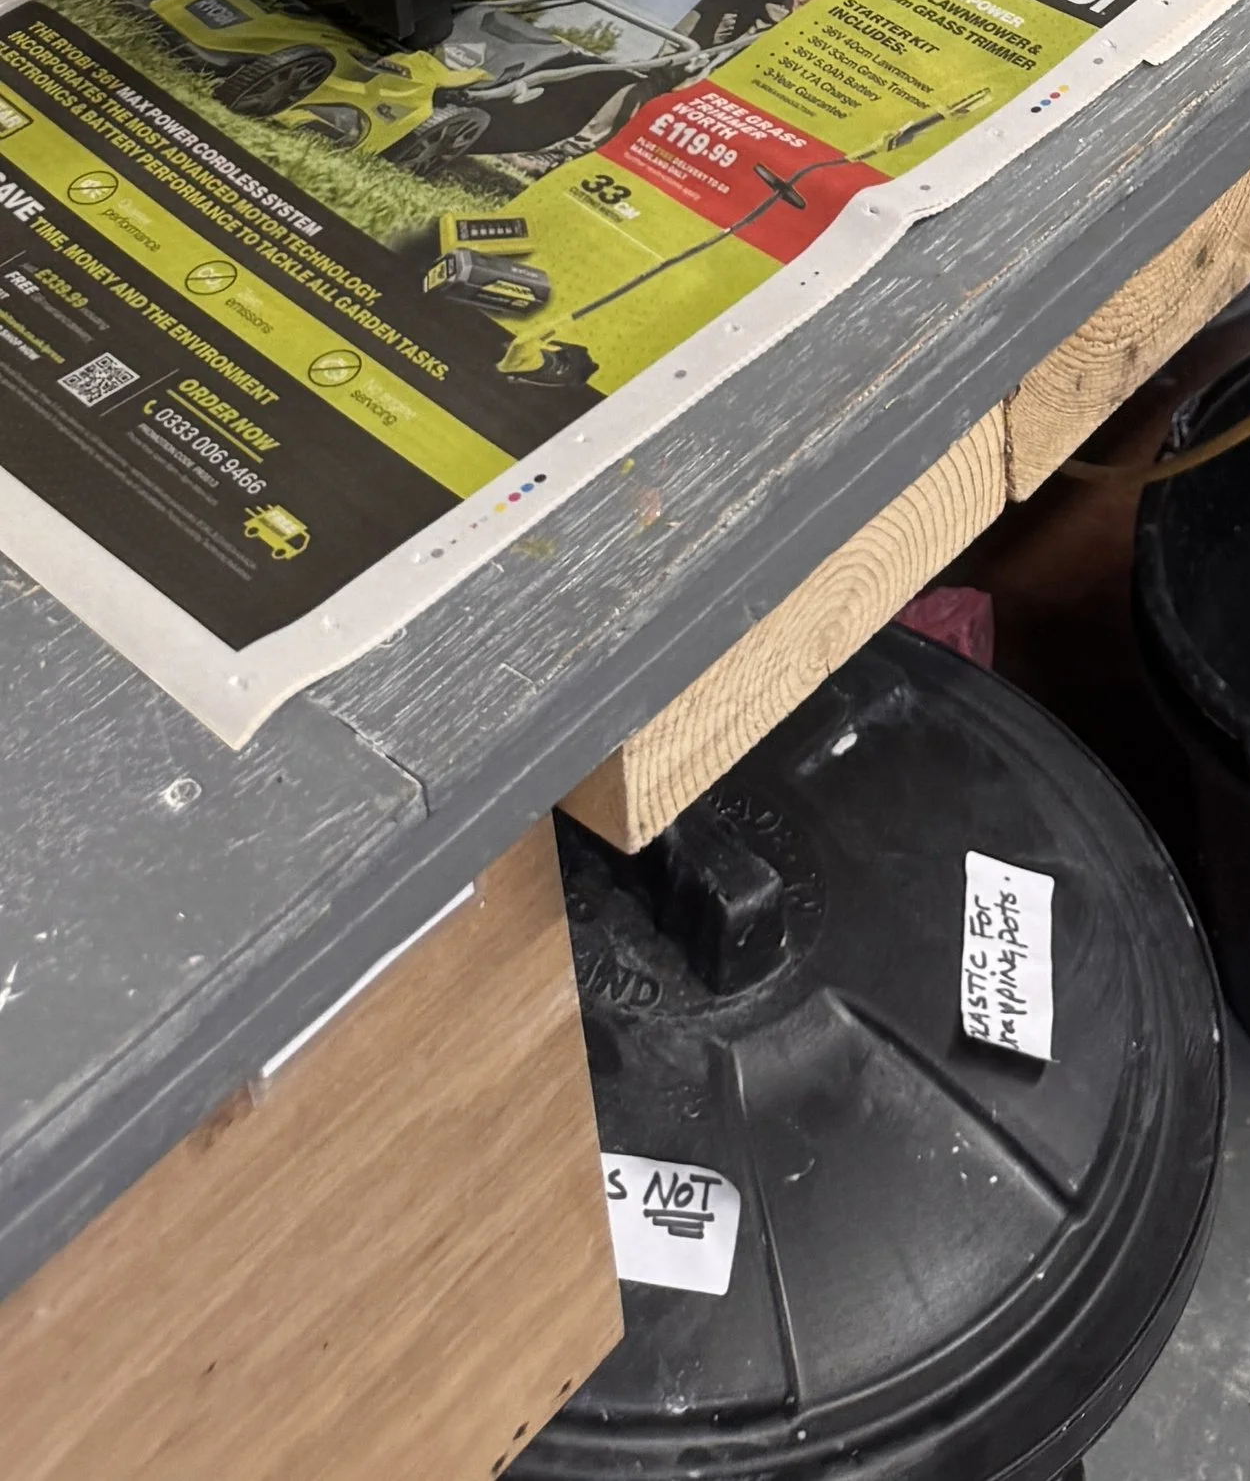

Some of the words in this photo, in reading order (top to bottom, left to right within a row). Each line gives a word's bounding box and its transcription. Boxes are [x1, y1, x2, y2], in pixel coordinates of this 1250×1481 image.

[828, 5, 909, 57] INCLUDES:
[909, 35, 941, 55] KIT
[912, 4, 968, 36] GRASS
[964, 31, 1038, 72] TRIMMER
[1026, 43, 1043, 56] &
[777, 55, 802, 74] 36V
[820, 80, 862, 110] Charger
[792, 45, 816, 62] 36V
[813, 57, 846, 82] 5.0Ah
[843, 76, 883, 103] Battery
[807, 35, 832, 51] 36V
[827, 47, 858, 70] 33cm
[856, 65, 889, 88] Grass
[887, 80, 931, 111] Trimmer
[821, 24, 846, 41] 36V
[843, 38, 873, 60] 40cm
[871, 52, 935, 95] Lawnmower
[688, 97, 769, 141] TRIMMER
[763, 67, 797, 90] 3-Year
[794, 85, 848, 120] Guarantee
[28, 20, 55, 45] THE
[51, 36, 95, 71] RYOBI
[91, 67, 123, 91] 36V
[115, 85, 153, 114] MAX
[149, 106, 200, 148] POWER
[193, 142, 271, 199] CORDLESS
[261, 191, 323, 237] SYSTEM
[648, 112, 739, 169] £119.99
[671, 102, 740, 141] WORTH
[700, 92, 749, 118] FREE
[744, 112, 808, 149] GRASS
[8, 30, 107, 103] INCORPORATES
[102, 98, 132, 125] THE
[127, 116, 171, 149] MOST
[163, 141, 236, 204] ADVANCED
[231, 197, 289, 239] MOTOR
[283, 232, 383, 306] TECHNOLOGY,
[629, 143, 671, 172] MAINLAND
[666, 163, 690, 182] ONLY
[635, 135, 657, 151] PLUS
[671, 155, 709, 182] DELIVERY
[580, 174, 632, 206] 33
[80, 108, 143, 160] BATTERY
[138, 149, 241, 234] PERFORMANCE
[235, 223, 260, 247] TO
[255, 239, 315, 284] TACKLE
[305, 275, 334, 304] ALL
[333, 294, 402, 345] GARDEN
[394, 335, 450, 382] TASKS.
[99, 207, 161, 254] performance
[4, 270, 40, 296] FREE
[34, 268, 89, 310] £339.99
[29, 215, 70, 253] TIME,
[63, 242, 121, 287] MONEY
[108, 282, 151, 310] AND
[142, 302, 179, 332] THE
[169, 323, 280, 406] ENVIRONMENT
[223, 296, 275, 335] emissions
[178, 378, 240, 427] ORDER
[232, 417, 281, 451] NOW
[350, 388, 398, 428] servicing
[154, 407, 199, 442] 0333
[191, 436, 228, 465] 006
[220, 457, 267, 496] 9466
[643, 1170, 723, 1212] NOT
